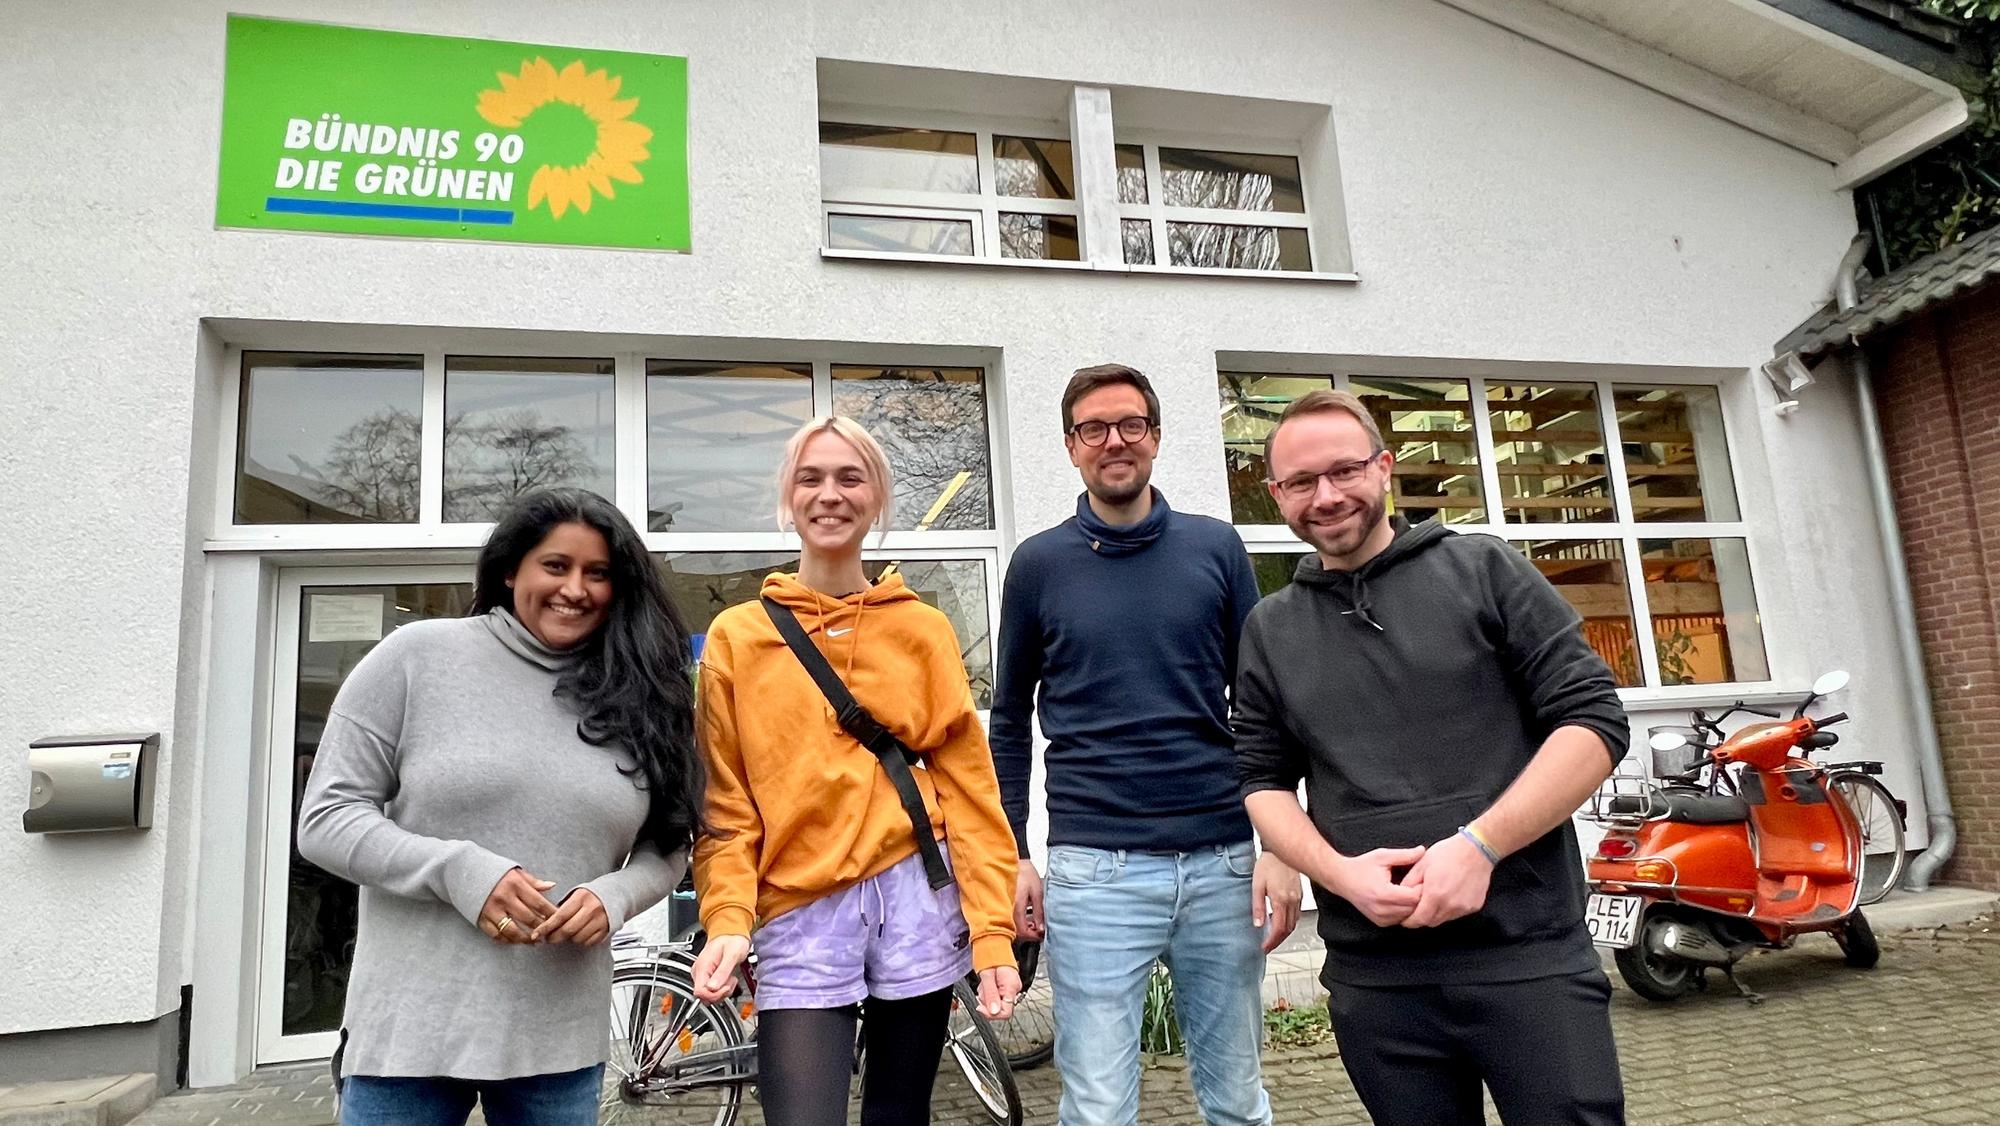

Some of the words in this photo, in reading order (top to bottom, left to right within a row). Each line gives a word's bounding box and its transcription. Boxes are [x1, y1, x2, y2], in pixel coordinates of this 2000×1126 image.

[283, 113, 461, 160] BÜNDNIS
[474, 132, 525, 165] 90
[274, 157, 343, 192] DIE
[354, 157, 515, 202] GRÜNEN
[1597, 897, 1637, 919] LEV
[1606, 920, 1629, 941] 114
